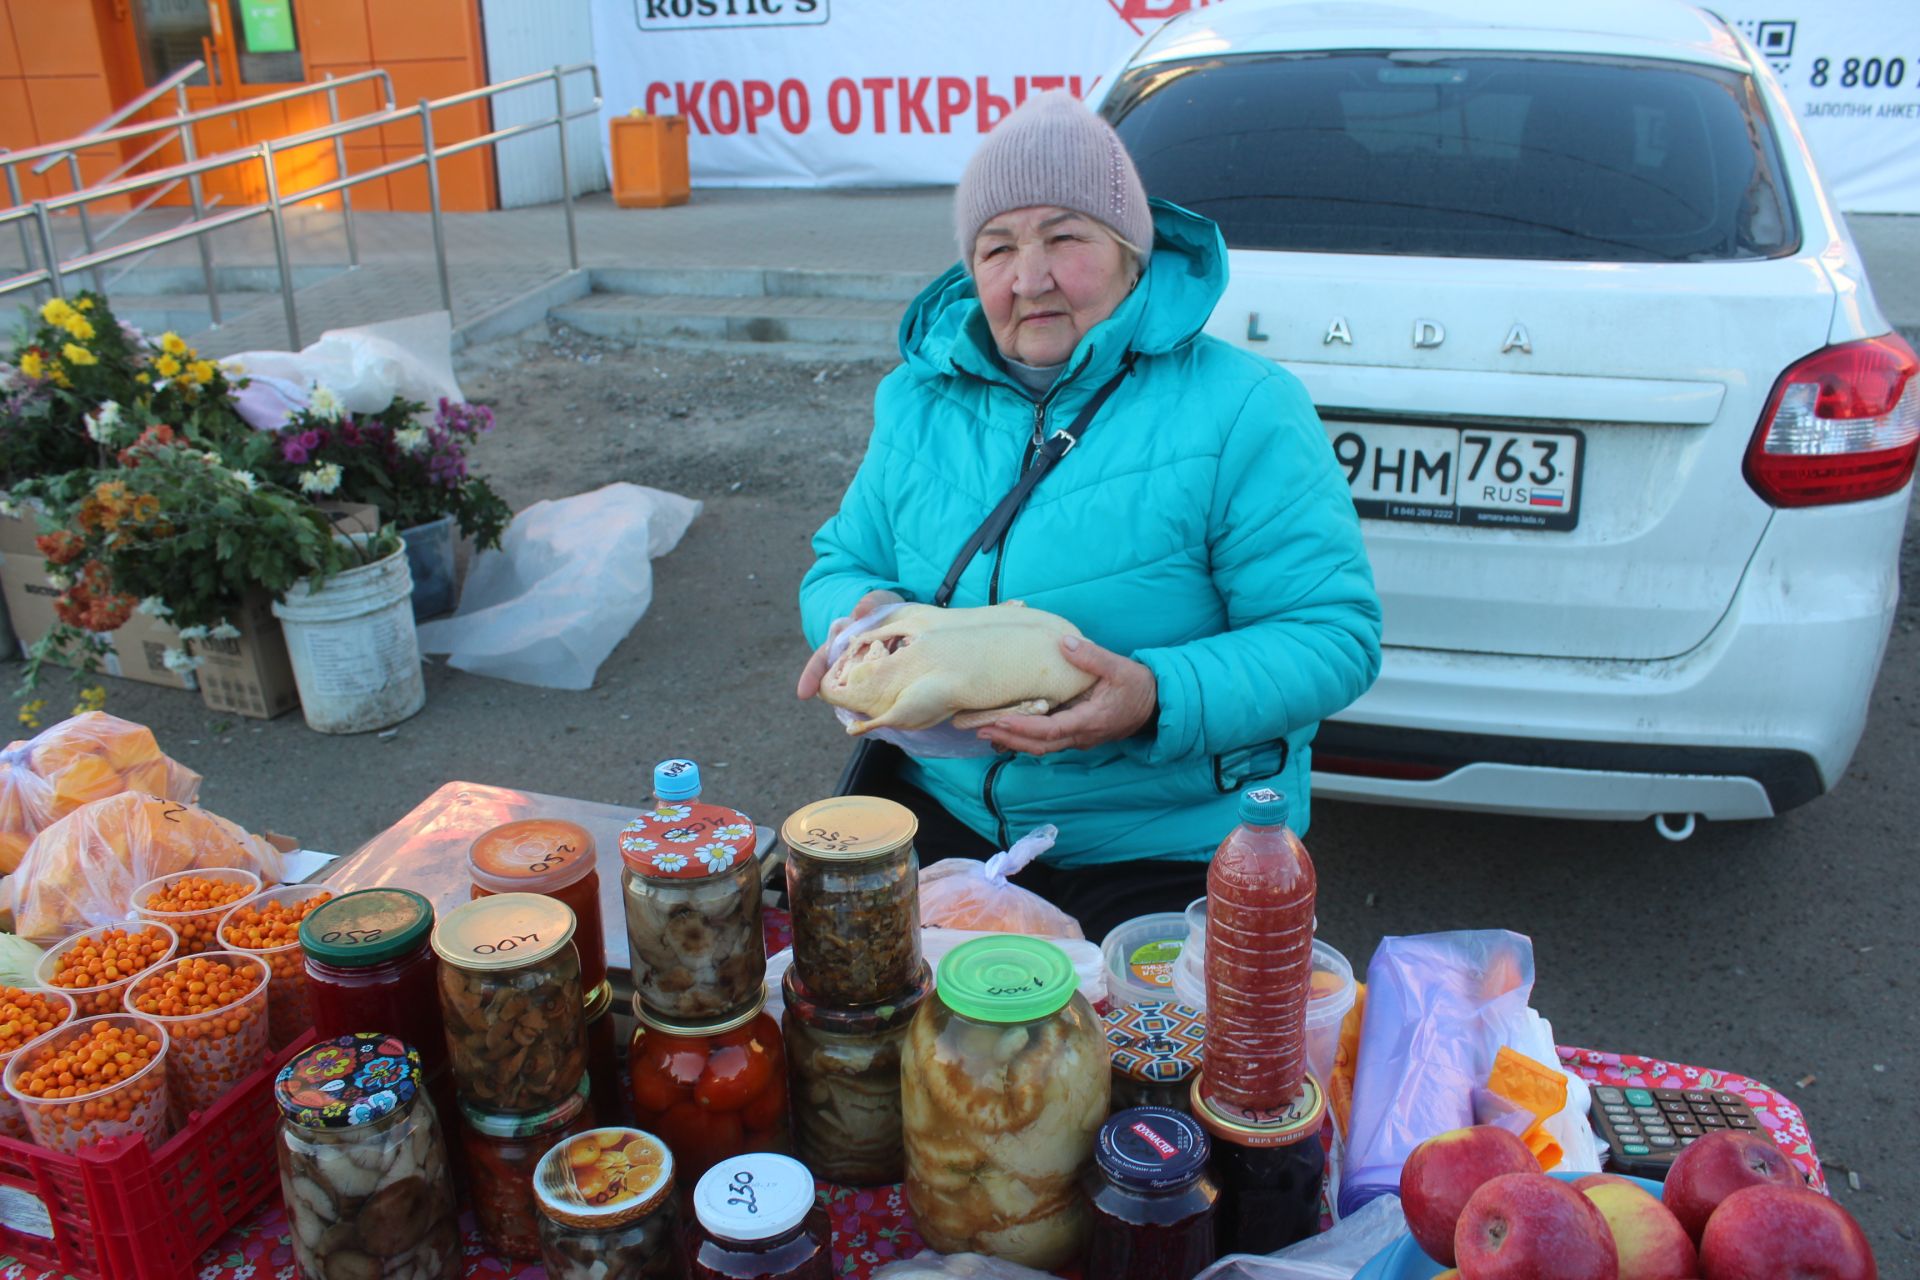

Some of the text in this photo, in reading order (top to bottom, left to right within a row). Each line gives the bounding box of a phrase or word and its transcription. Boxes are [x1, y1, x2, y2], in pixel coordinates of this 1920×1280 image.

[645, 0, 817, 19] ROSTICS
[1809, 57, 1829, 88] 8
[1840, 57, 1905, 88] 800
[645, 75, 1102, 135] СКОРО ОТКРЫ
[1804, 101, 1873, 118] ЗАПОЛНИ
[1247, 311, 1532, 354] LADA
[1464, 436, 1559, 486] 763
[1483, 486, 1527, 503] RUS
[529, 844, 576, 873] 250
[321, 928, 382, 945] 250
[473, 933, 540, 955] 400
[727, 1171, 758, 1214] 250
